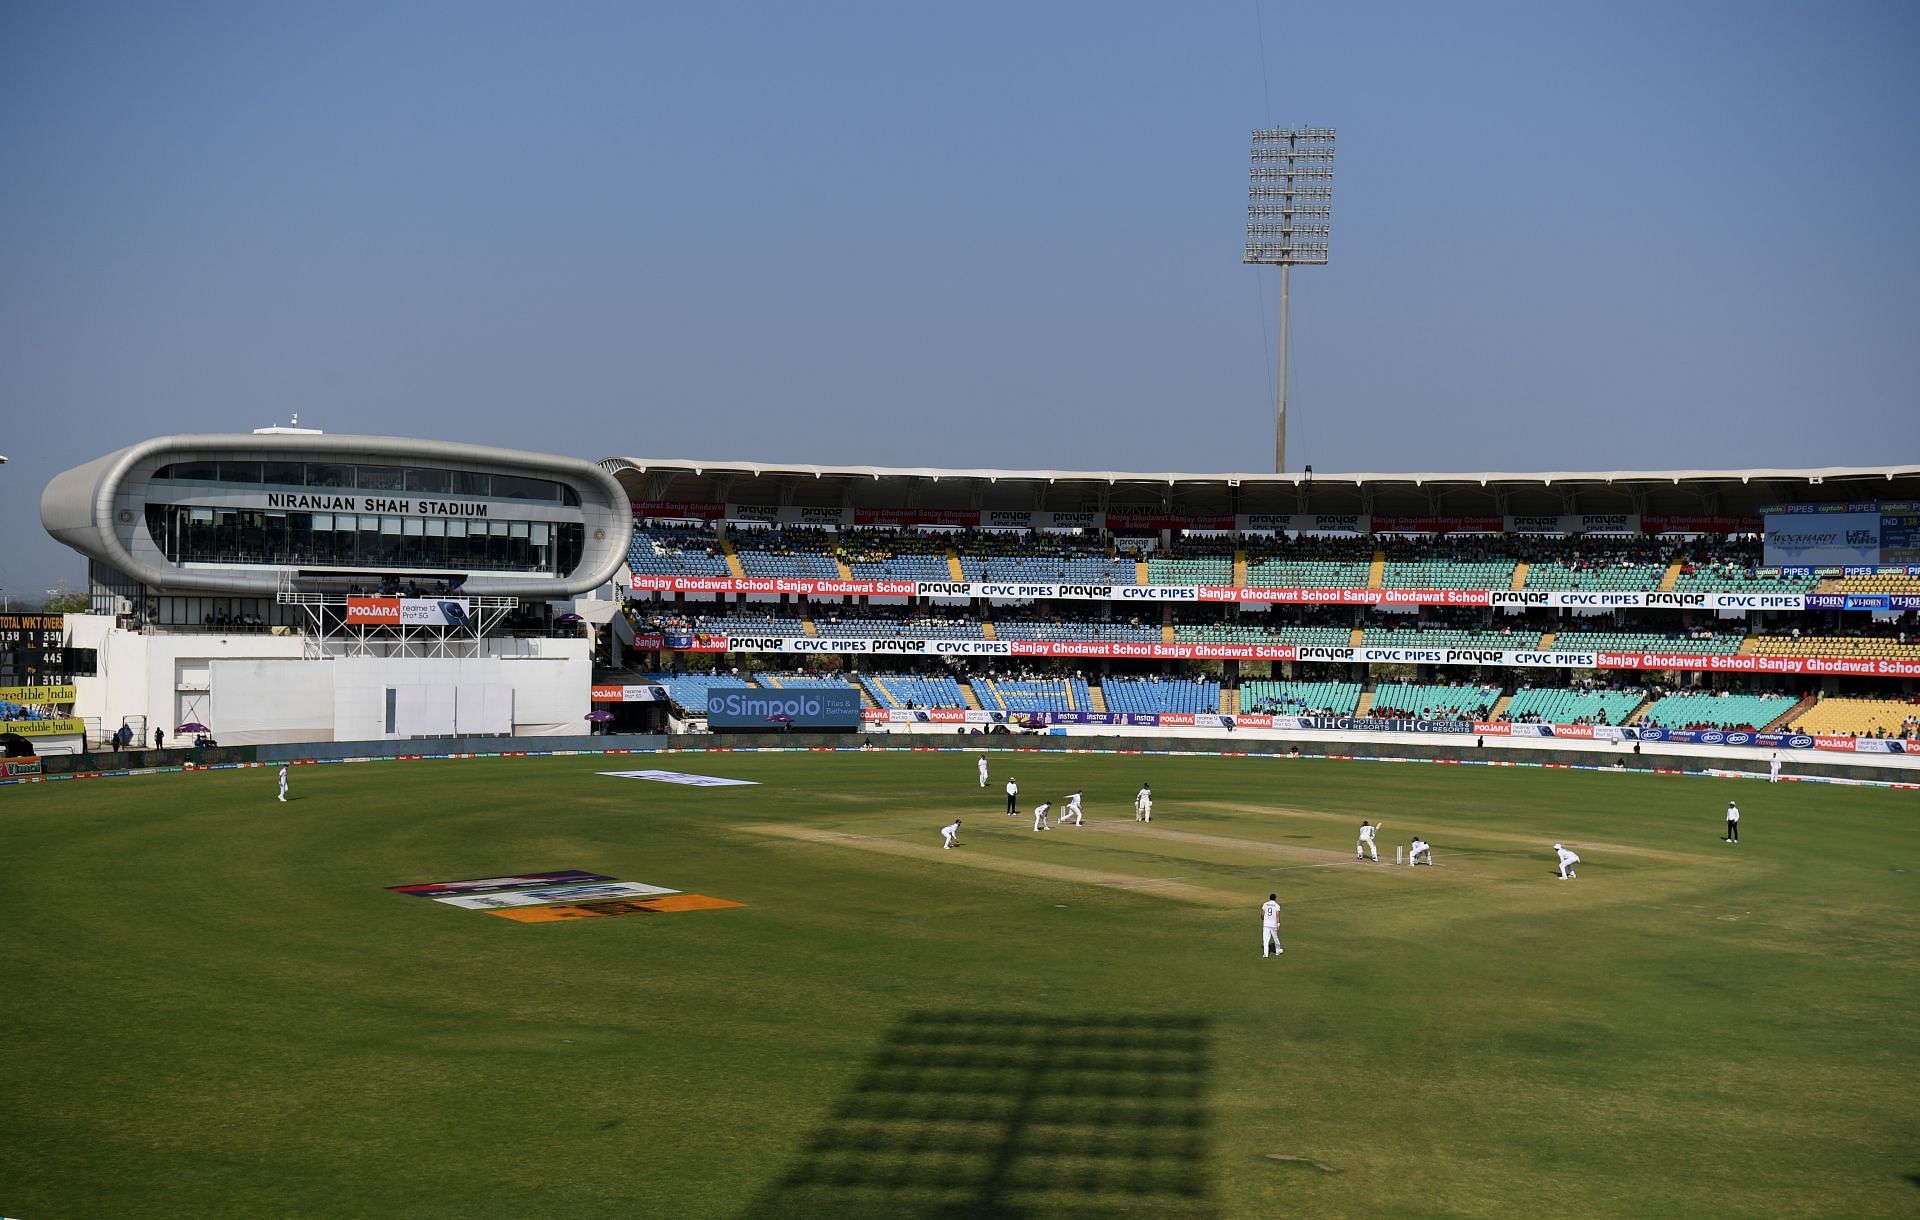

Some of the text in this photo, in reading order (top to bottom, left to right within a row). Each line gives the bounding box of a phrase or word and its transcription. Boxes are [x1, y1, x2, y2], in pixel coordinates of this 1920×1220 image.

[269, 494, 487, 516] NIRANJAN SHAH STADIUM
[634, 577, 914, 593] Sanjay Ghodawat School Sanjay Ghodawat School
[918, 583, 1194, 598] prayag CPVC PIPES prayag CPVC PIPES
[1200, 588, 1488, 603] Sanjay Ghodawat School Sanjay Ghodawat School
[1492, 593, 1800, 607] prayag CPVC PIPES prayag CPVC PIPES
[1805, 596, 1844, 606] VI-JOHN
[349, 604, 398, 617] POOJARA
[0, 616, 64, 630] TOTAL WKT OVERS
[0, 631, 20, 641] 138
[635, 637, 660, 648] Sanjay
[702, 639, 728, 648] School
[730, 638, 1008, 653] prayag CPVC PIPES prayag CPVC PIPES
[1012, 642, 1297, 658] Sanjay Ghodawat School Sanjay Ghodawat School
[44, 653, 62, 663] 445
[1300, 648, 1592, 664] prayag CPVC PIPES prayag CPVC PIPES
[1596, 653, 1639, 667] Sanjay
[1644, 655, 1705, 667] Ghodawat
[1711, 657, 1754, 668] School
[1759, 658, 1802, 672] Sanjay
[1807, 659, 1874, 672] Ghodawat
[43, 676, 62, 685] 319
[726, 694, 820, 718] Simpolo
[932, 710, 964, 719] POOJARA
[1160, 715, 1193, 723] POOJARA
[1238, 716, 1271, 725] POOJARA
[1318, 718, 1348, 729] IHG
[6, 722, 50, 732] Incredible
[1397, 721, 1428, 731] IHG
[1475, 723, 1510, 732] POOJARA
[1557, 726, 1592, 735] POOJARA
[1815, 739, 1854, 748] POOJARA
[1268, 908, 1272, 916] 9
